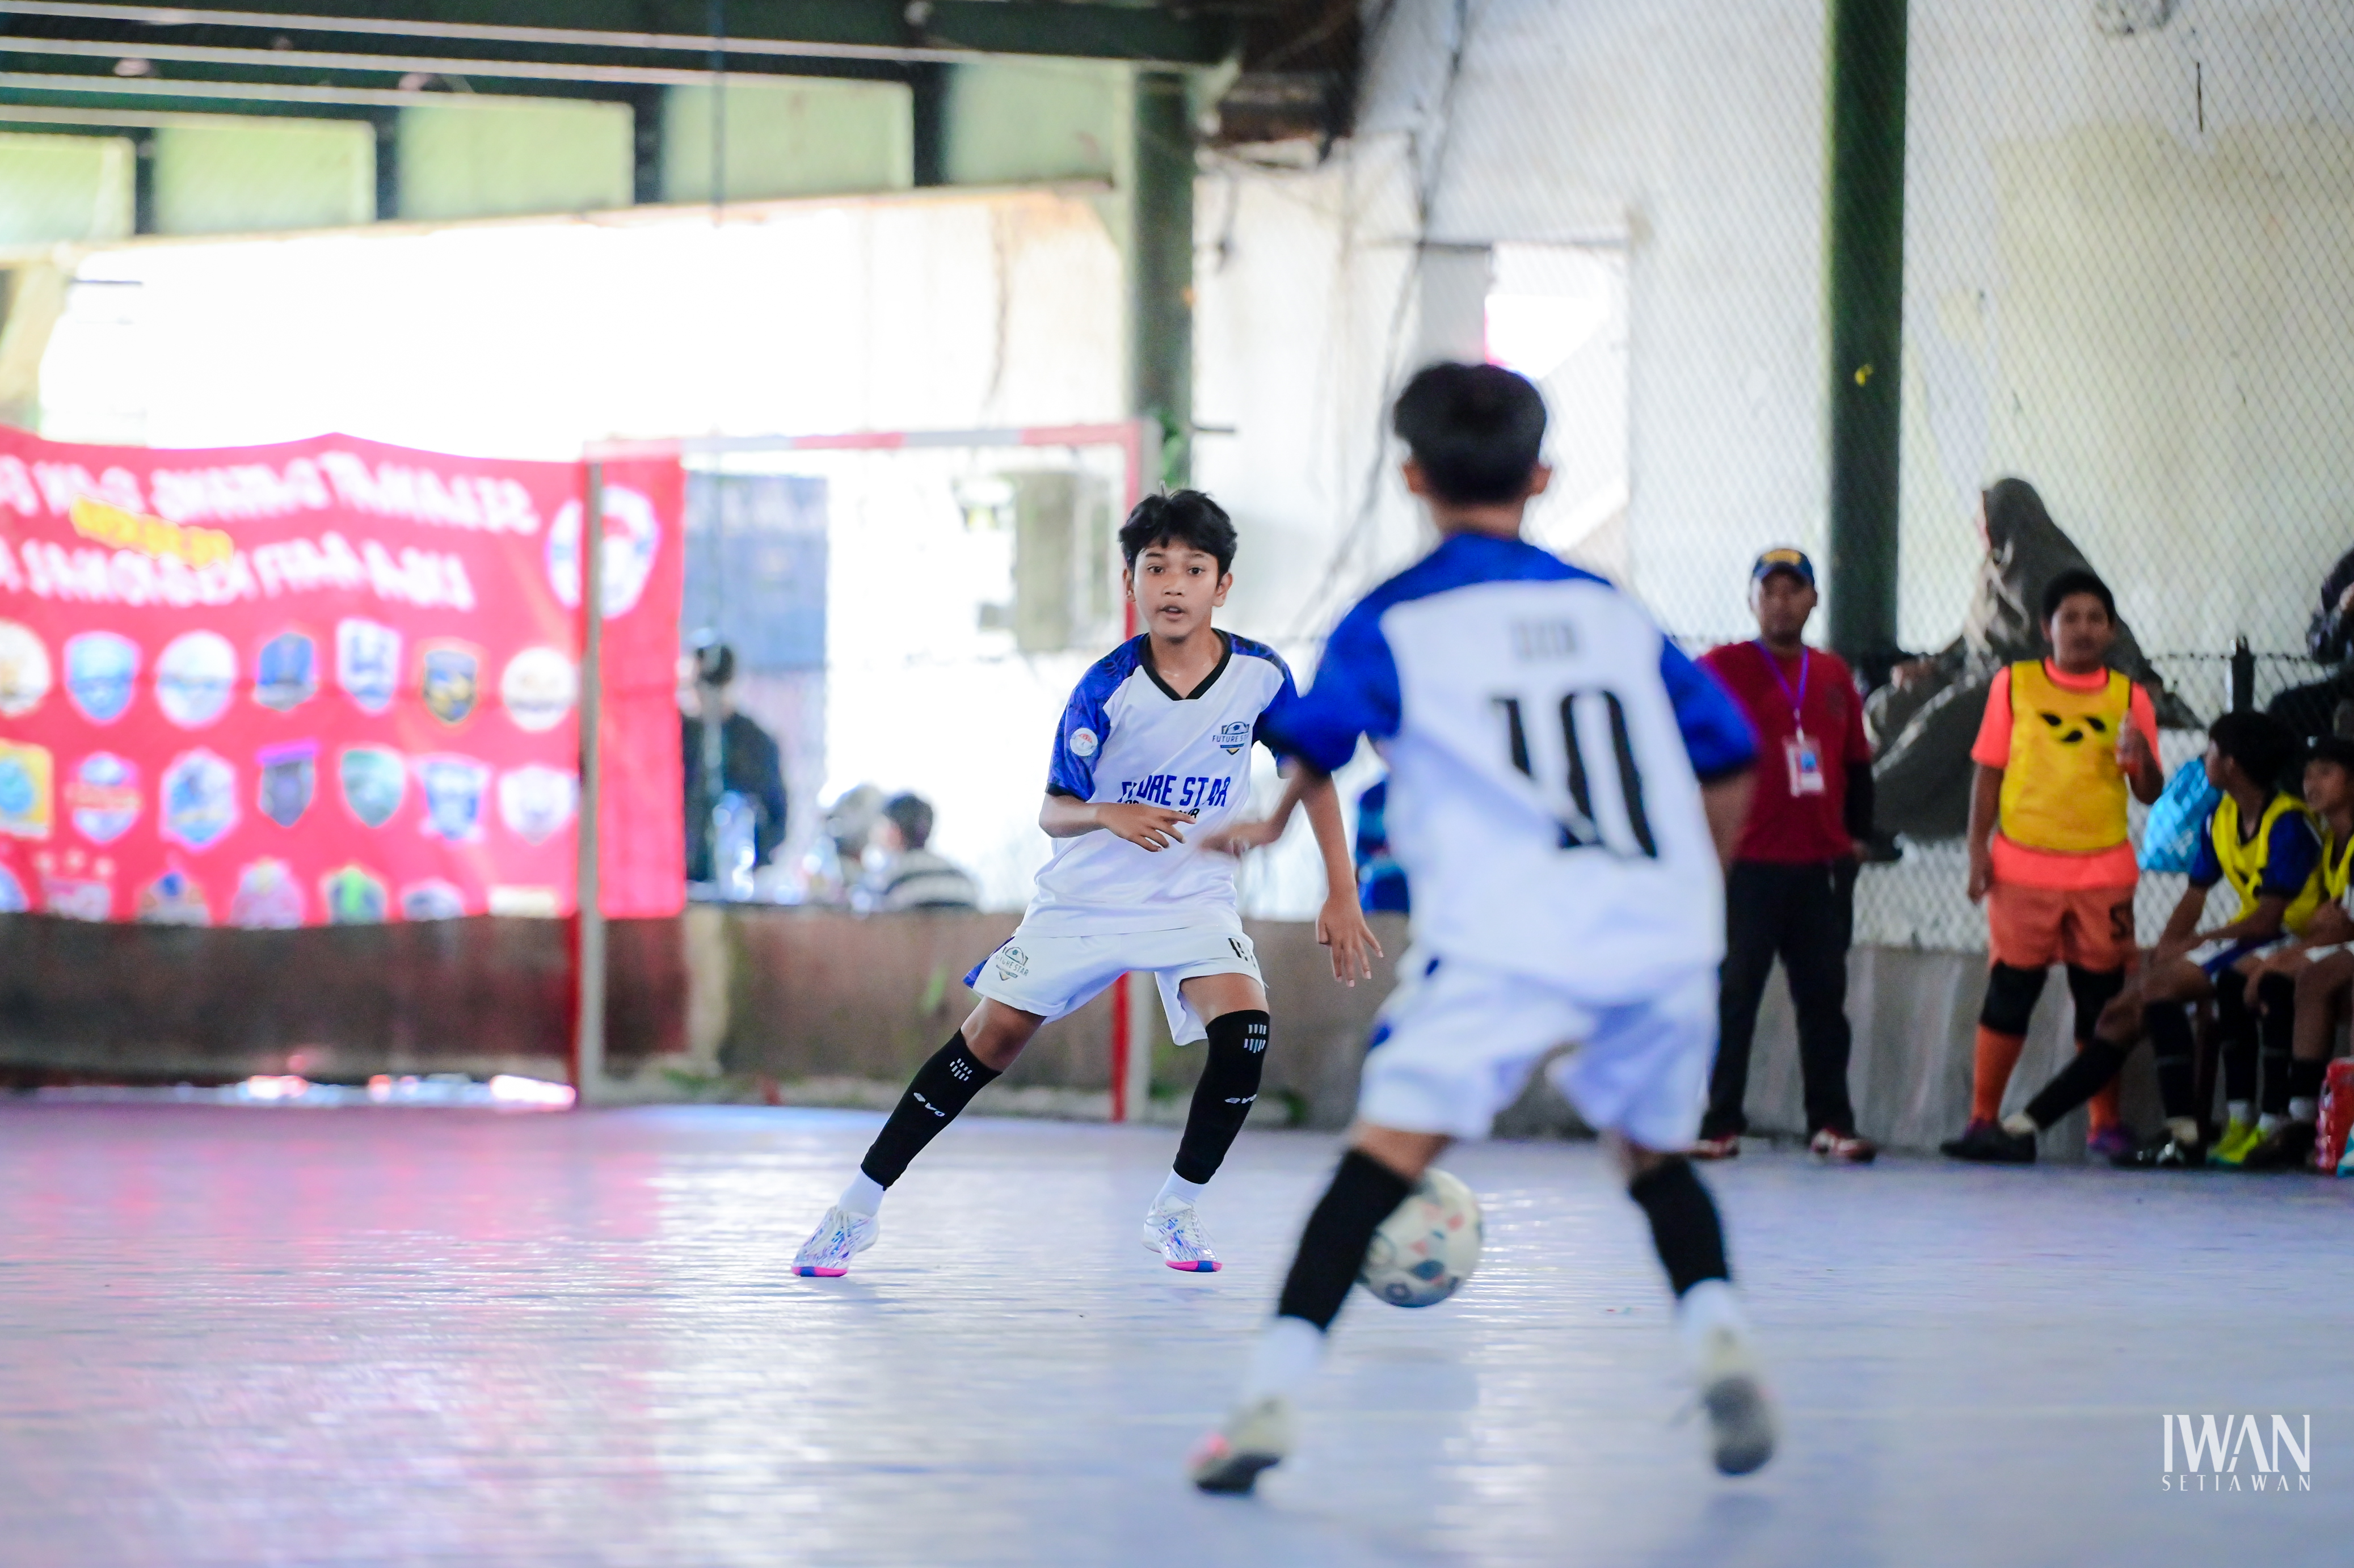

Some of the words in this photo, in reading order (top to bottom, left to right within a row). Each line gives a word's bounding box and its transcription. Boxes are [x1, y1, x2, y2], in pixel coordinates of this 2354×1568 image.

[1490, 688, 1657, 859] 10
[1180, 777, 1231, 807] STAR
[1013, 964, 1029, 976] STAR
